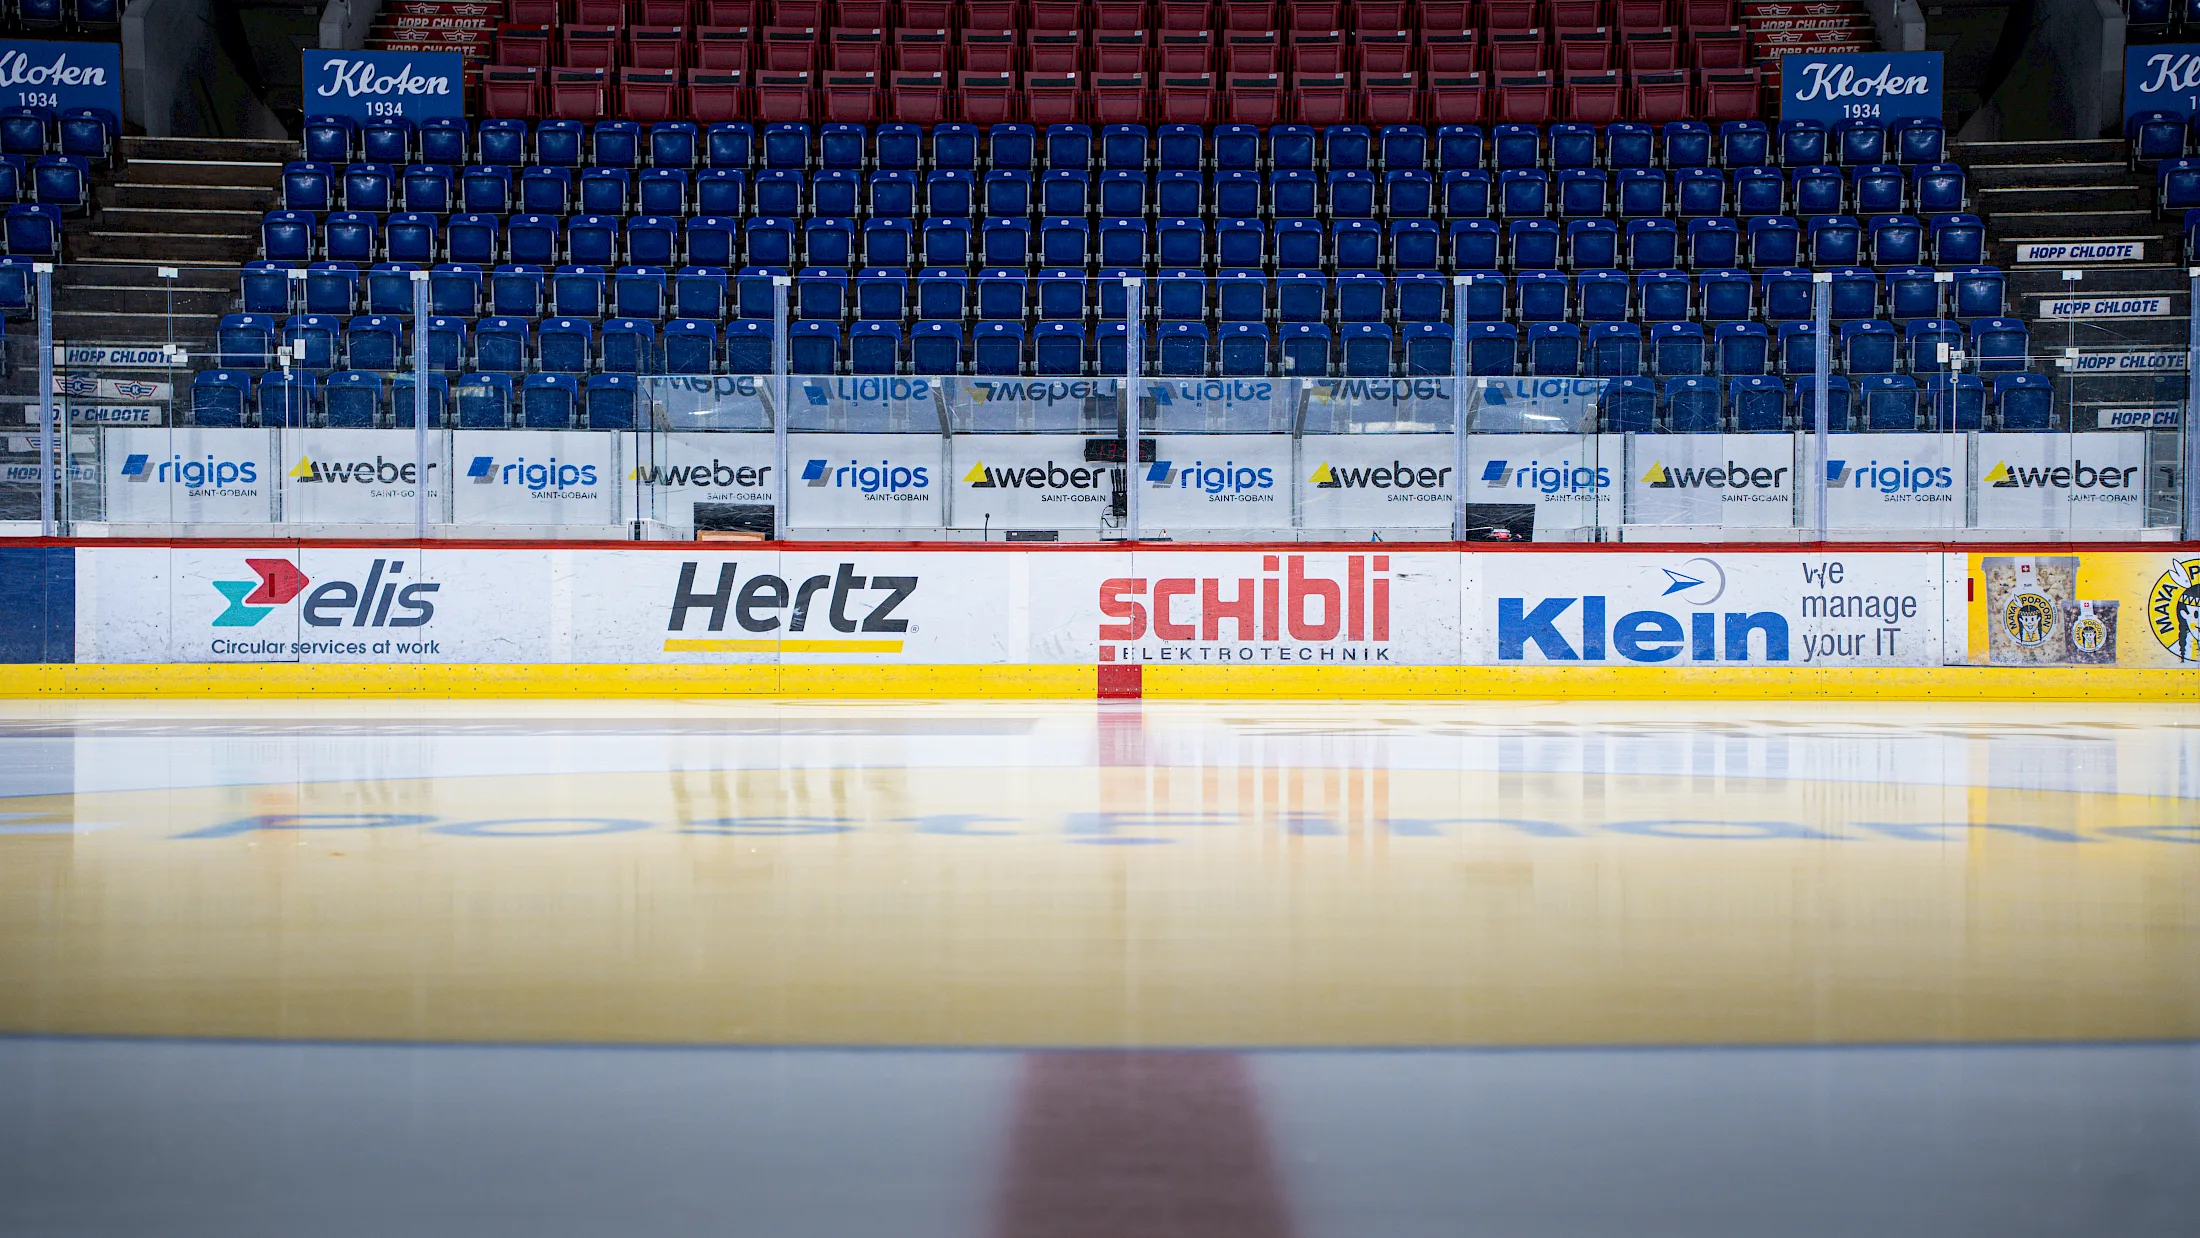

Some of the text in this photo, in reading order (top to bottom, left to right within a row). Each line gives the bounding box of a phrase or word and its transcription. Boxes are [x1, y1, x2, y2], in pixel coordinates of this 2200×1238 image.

[397, 17, 487, 29] HOPP CHLOOTE
[1760, 20, 1793, 30] HOPP
[317, 58, 450, 98] Kloten
[1795, 62, 1929, 101] Kloten
[18, 92, 58, 107] 1934
[365, 101, 403, 117] 1934
[1843, 103, 1881, 119] 1934
[2029, 245, 2133, 259] HOPP CHLOOTE
[2052, 300, 2160, 315] HOPP CHLOOTE
[68, 350, 106, 363] HOPP
[2076, 354, 2185, 369] HOPP CHLOOTE
[84, 408, 150, 422] CHLOOTE
[2111, 412, 2152, 425] HOPP
[159, 454, 257, 489] rigips
[319, 455, 437, 484] weber
[503, 457, 598, 490] rigips
[640, 459, 772, 487] weber
[836, 460, 929, 492] rigips
[995, 460, 1106, 489] weber
[1181, 461, 1274, 494] rigips
[1340, 460, 1452, 489] weber
[1516, 460, 1611, 494] rigips
[1674, 460, 1788, 489] weber
[1855, 459, 1953, 493] rigips
[2020, 459, 2138, 489] weber
[188, 489, 258, 498] SAINT-GOBAIN
[370, 489, 437, 498] SAINT-GOIN
[531, 491, 597, 500] SAINT-GOBAIN
[706, 492, 773, 501] SAINT-GOBAIN
[864, 493, 929, 502] SAINT-GOBAIN
[1041, 494, 1107, 503] SAINT-GOBAIN
[1208, 494, 1274, 502] SAINT-GOBAIN
[1387, 494, 1453, 502] SAINT-GOBAIN
[1884, 494, 1953, 502] SAINT-GOBAIN
[2067, 494, 2138, 502] SAINT-GOBAIN
[1802, 561, 1845, 584] we
[302, 558, 441, 628] elis
[1802, 595, 1918, 625] manage
[2007, 605, 2019, 631] MAYA
[2020, 595, 2052, 629] POPCORN
[2154, 583, 2179, 635] MAYA
[1497, 594, 1790, 663] Klein
[211, 639, 441, 655] Circular services at work
[1802, 628, 1901, 663] your IT
[1122, 647, 1390, 661] ELEKTROTECHNIK
